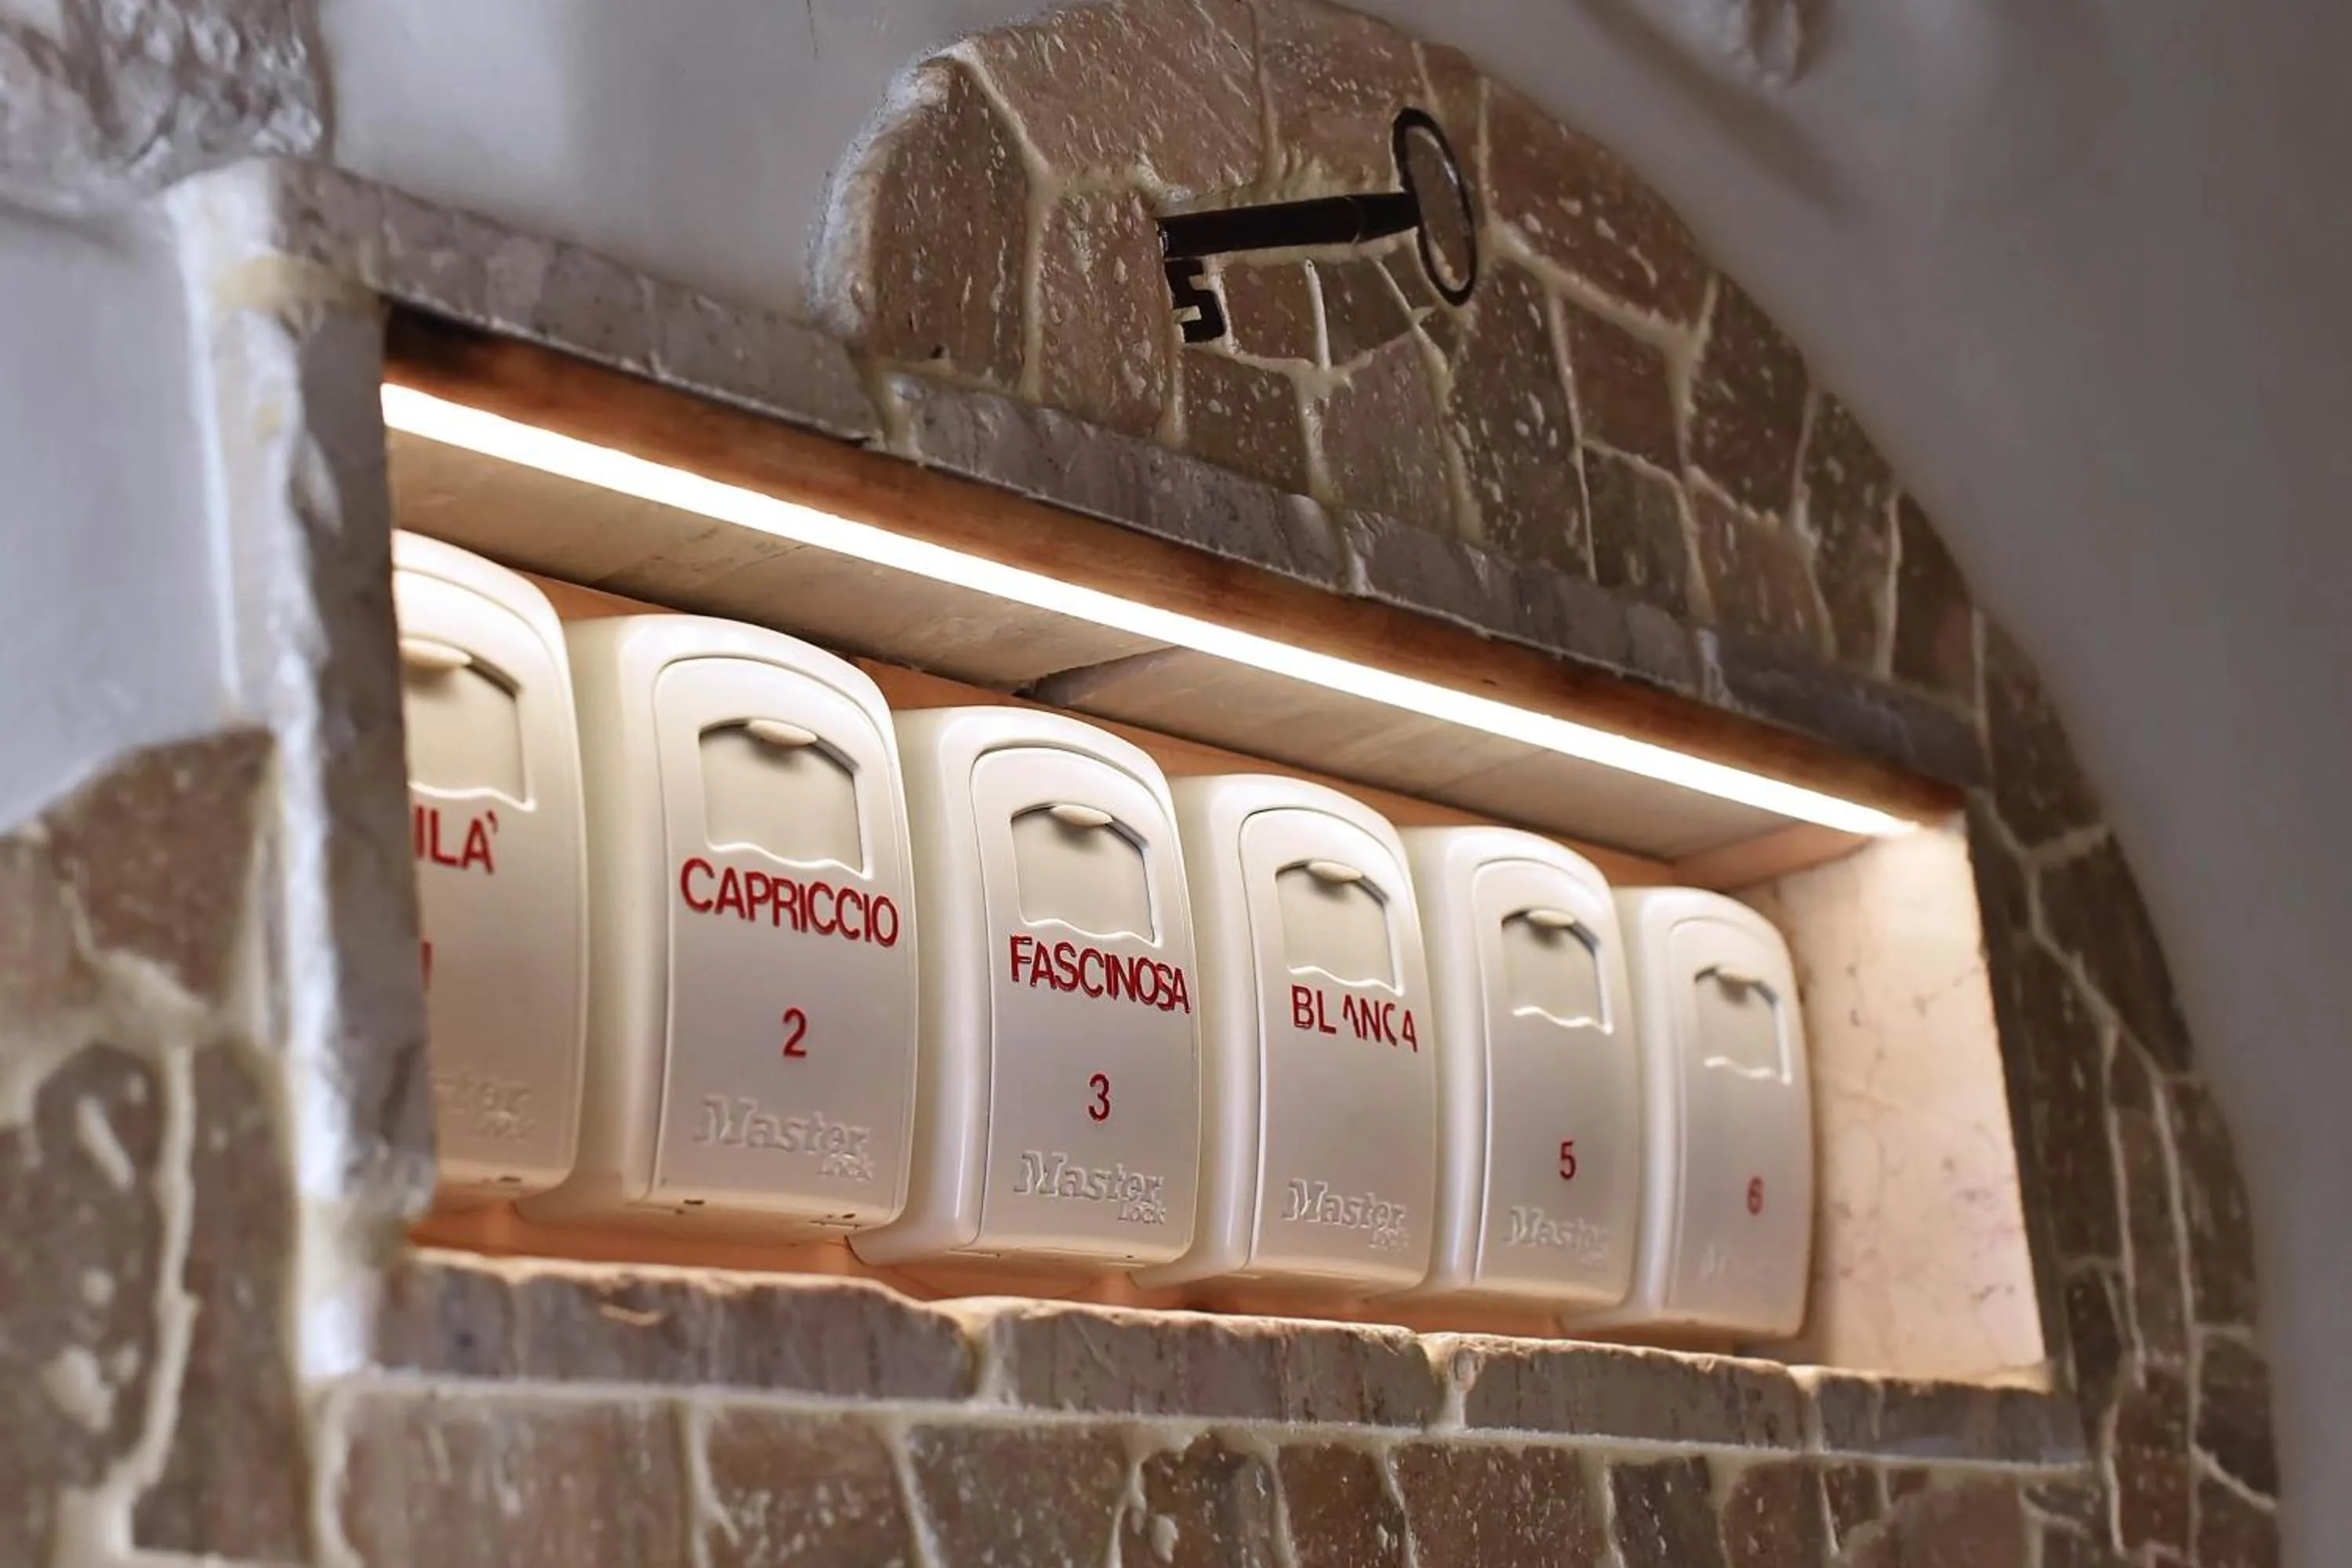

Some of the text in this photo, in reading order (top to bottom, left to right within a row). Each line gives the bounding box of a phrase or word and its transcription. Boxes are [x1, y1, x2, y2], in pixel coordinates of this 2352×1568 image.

[679, 857, 899, 947] CAPRICCIO
[1009, 934, 1191, 1014] FASCINOSA
[782, 1007, 808, 1058] 2
[1290, 984, 1418, 1053] BLANCA
[1087, 1072, 1111, 1122] 3
[693, 1094, 873, 1157] Master
[1014, 1149, 1165, 1204] Master
[1559, 1140, 1577, 1181] 5
[1281, 1178, 1406, 1231] Master
[1746, 1176, 1765, 1217] 6
